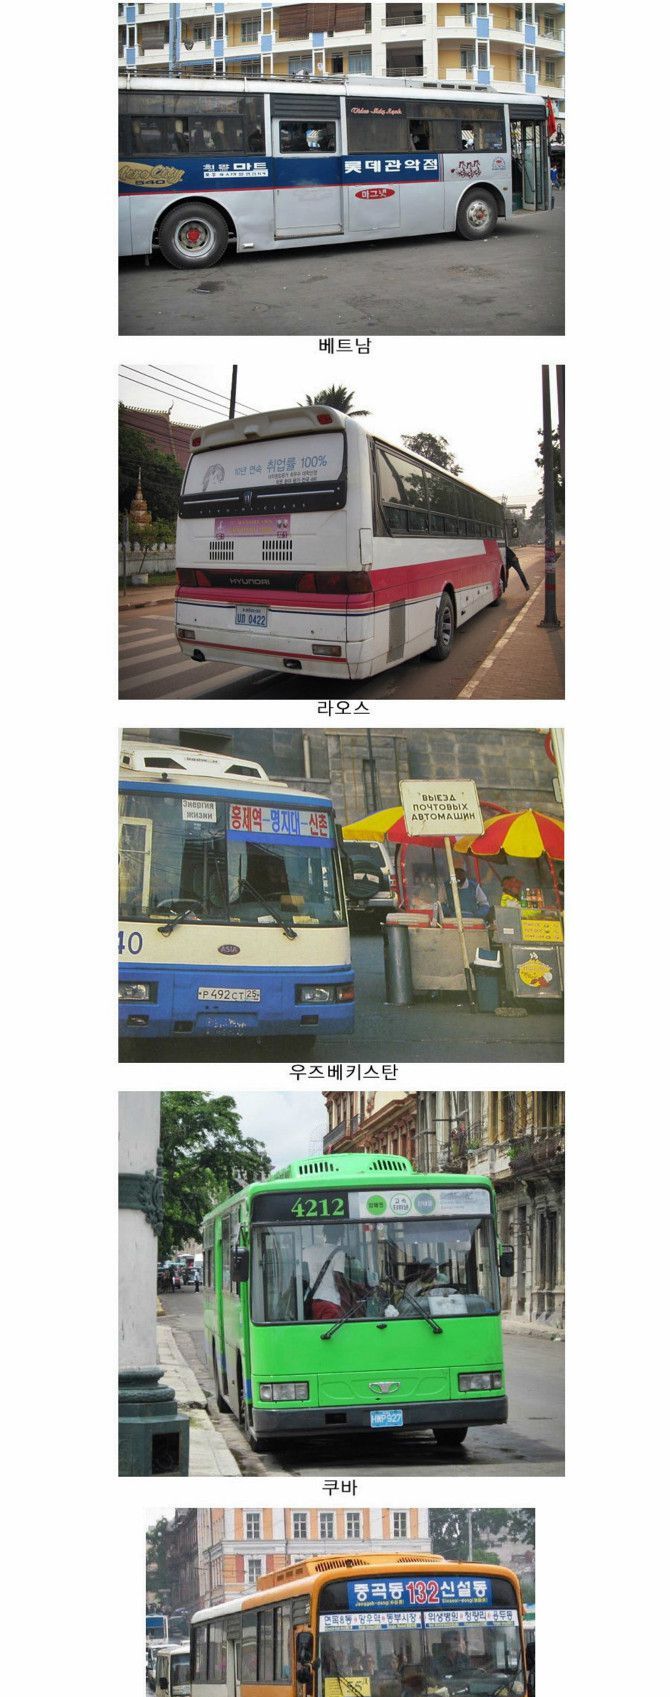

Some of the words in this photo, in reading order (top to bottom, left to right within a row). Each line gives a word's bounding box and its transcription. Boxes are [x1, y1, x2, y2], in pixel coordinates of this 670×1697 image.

[266, 456, 297, 473] 취업률
[301, 455, 328, 468] 100%
[422, 794, 456, 802] ВЫЕЗД
[413, 803, 468, 811] ПОЧТОВЫХ
[411, 812, 475, 821] АВТОМАШИН
[291, 1197, 346, 1218] 4212
[354, 1582, 404, 1602] 중곡동
[406, 1580, 440, 1605] 132
[440, 1580, 487, 1598] 신설동
